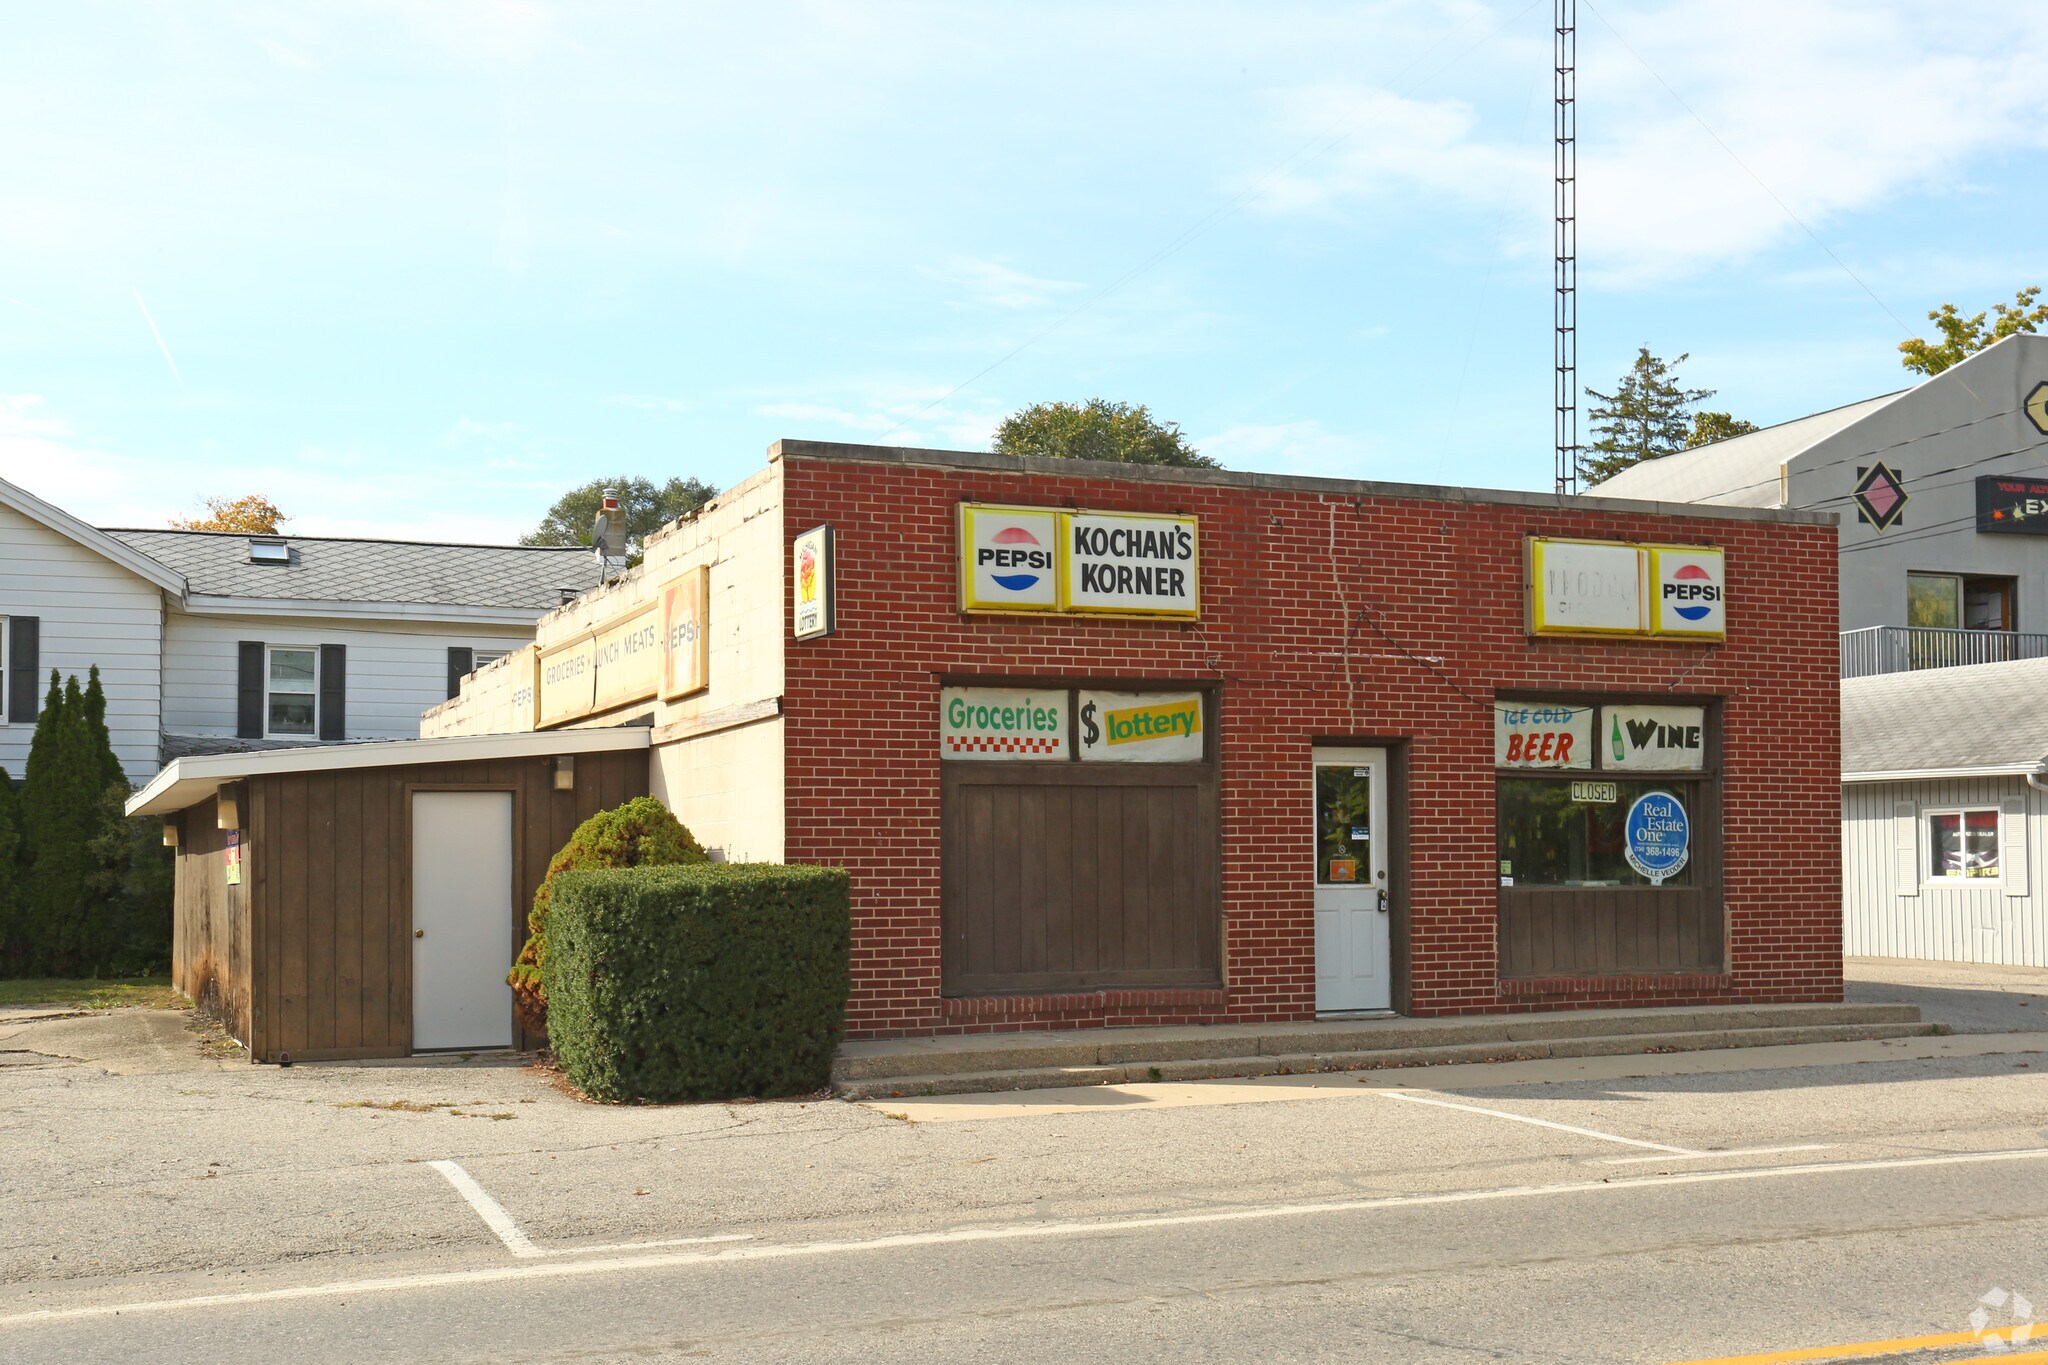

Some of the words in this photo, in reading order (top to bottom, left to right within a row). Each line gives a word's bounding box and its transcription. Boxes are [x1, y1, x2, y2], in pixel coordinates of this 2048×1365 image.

[1998, 482, 2025, 493] YOUR
[1074, 525, 1193, 561] KOCHAN'S
[978, 548, 1052, 570] PEPSI
[1081, 563, 1186, 598] KORNER
[1663, 583, 1721, 602] PEPSI
[664, 619, 699, 653] PEPSI
[546, 654, 585, 686] GROCERIES
[593, 643, 619, 670] LUNCH
[624, 625, 655, 656] MEATS
[512, 686, 533, 708] PEPS
[947, 696, 1058, 732] Groceries
[1080, 699, 1100, 749] $
[1108, 709, 1195, 741] lottery
[1503, 708, 1528, 726] ICE
[1532, 706, 1573, 726] COLD
[1625, 717, 1700, 751] WINE
[1506, 732, 1574, 763] BEER
[1573, 782, 1616, 801] CLOSED
[1643, 802, 1672, 818] Real
[1636, 827, 1664, 842] One
[1647, 817, 1684, 832] Estate
[1629, 853, 1660, 877] MICHELLE
[1660, 857, 1686, 877] VEDDER
